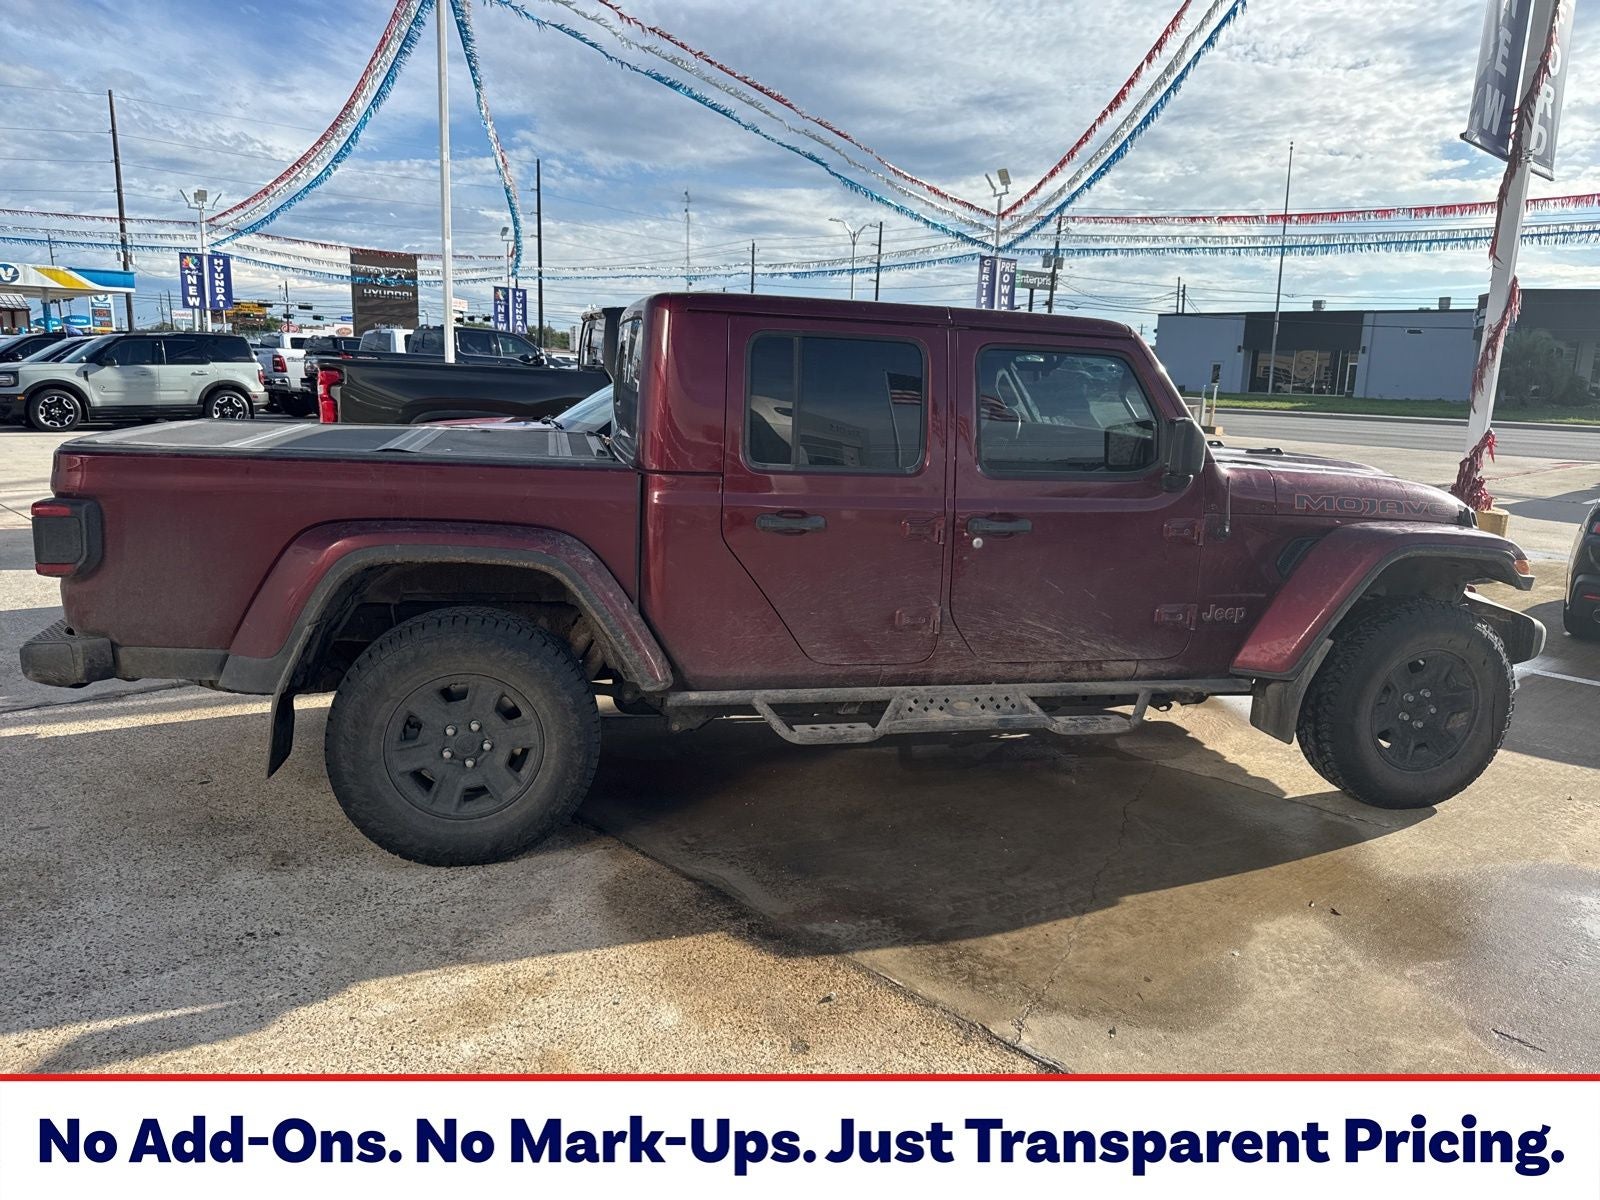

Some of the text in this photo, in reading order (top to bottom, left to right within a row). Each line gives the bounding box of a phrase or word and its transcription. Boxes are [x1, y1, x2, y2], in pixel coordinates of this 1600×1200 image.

[1000, 261, 1016, 273] PRE
[213, 258, 226, 308] HYUNDAI
[1016, 273, 1058, 288] enterpris
[187, 275, 201, 307] NEW
[363, 288, 413, 300] HYUNDAI
[1201, 604, 1247, 624] Jeep
